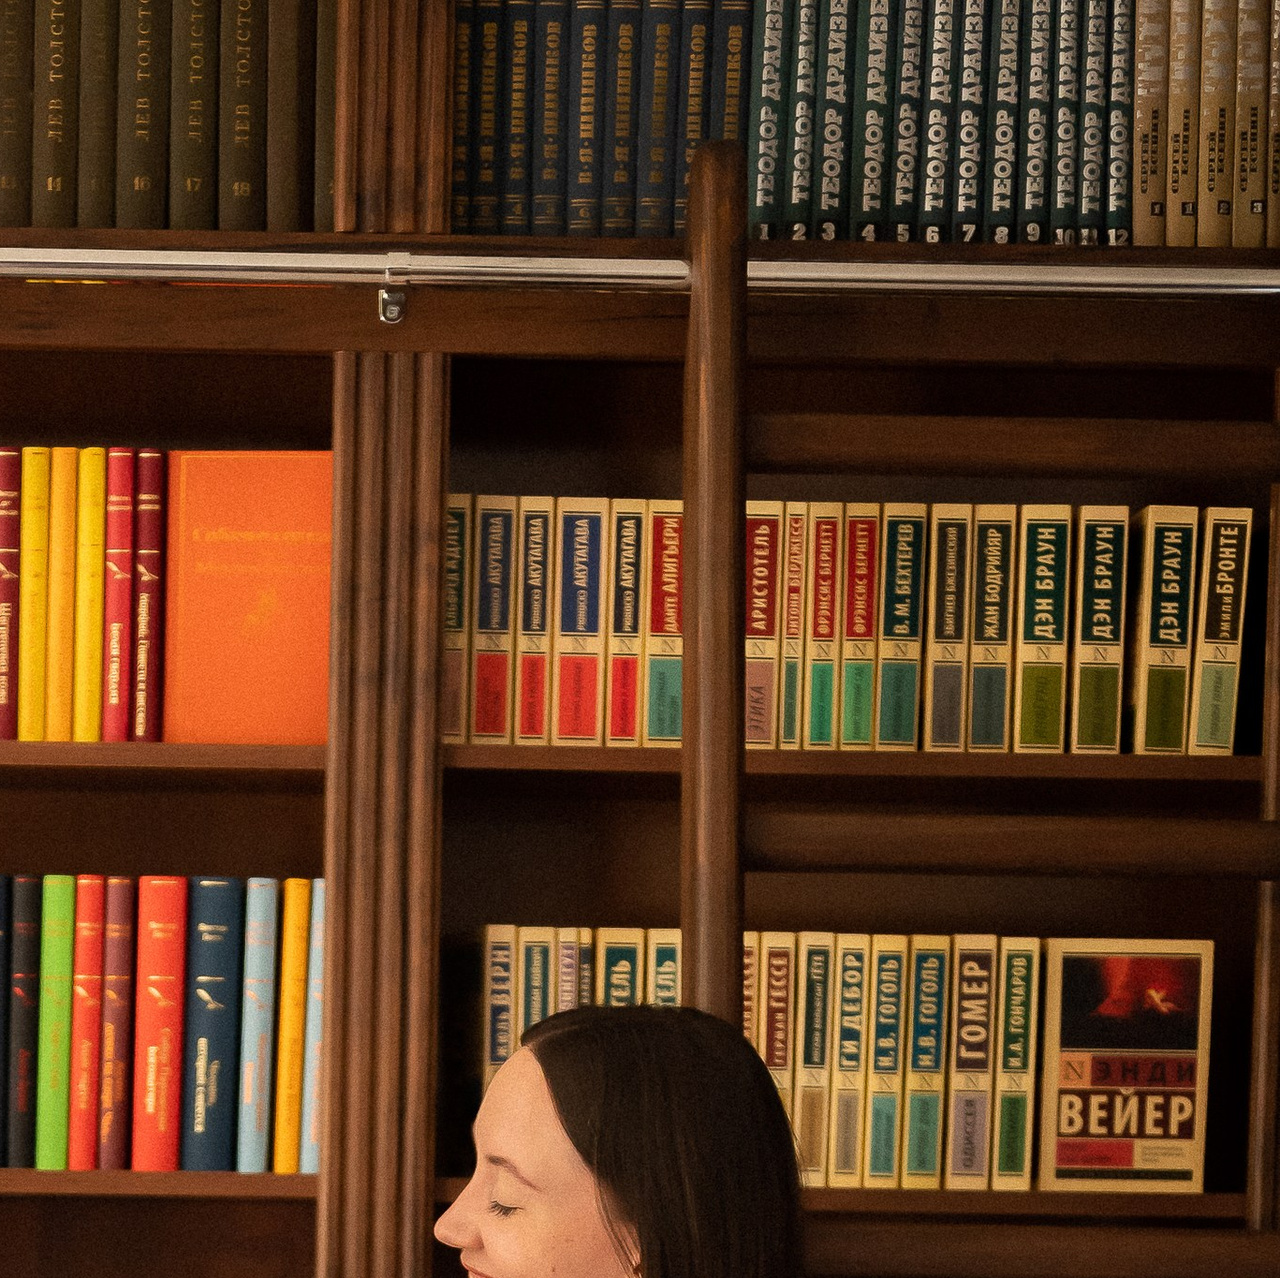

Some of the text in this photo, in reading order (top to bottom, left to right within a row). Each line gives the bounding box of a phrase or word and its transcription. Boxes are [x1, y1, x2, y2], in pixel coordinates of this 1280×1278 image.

[821, 109, 844, 211] ТЕОДОР
[862, 110, 885, 212] ТЕОДОР
[925, 109, 948, 212] ТЕОДОР
[958, 110, 981, 212] ТЕОДОР
[992, 110, 1015, 212] ТЕОДОР
[1109, 110, 1129, 212] ТЕОДОР
[792, 223, 807, 241] 2
[822, 222, 836, 241] 3
[861, 223, 876, 242] 4
[897, 224, 910, 242] 5
[962, 224, 976, 242] 7
[1027, 223, 1040, 242] 9
[1108, 228, 1129, 247] 12
[574, 518, 590, 588] АКУТАГАВА
[620, 520, 636, 588] АКУТАГАВА
[662, 518, 680, 594] АЛИГЬЕРИ
[750, 524, 770, 630] АРИСТОТЕЛЬ
[894, 524, 914, 596] БЕХТЕРЕВ
[984, 528, 1002, 638] ЖАН БОДРИЙЯР
[1034, 528, 1056, 638] ДЭН БРАУН
[1092, 526, 1114, 638] ДЭН БРАУН
[1158, 532, 1182, 642] ДЭН БРАУН
[1216, 526, 1238, 594] БРОНТЕ
[840, 954, 862, 1068] ГИ ДЕБОР
[878, 958, 898, 1026] ГОГОЛЬ
[918, 956, 938, 1026] ГОГОЛЬ
[958, 960, 988, 1060] ГОМЕР
[1008, 956, 1026, 1034] ГОНЧАРОВ
[1059, 1087, 1194, 1136] ВЕЙЕР
